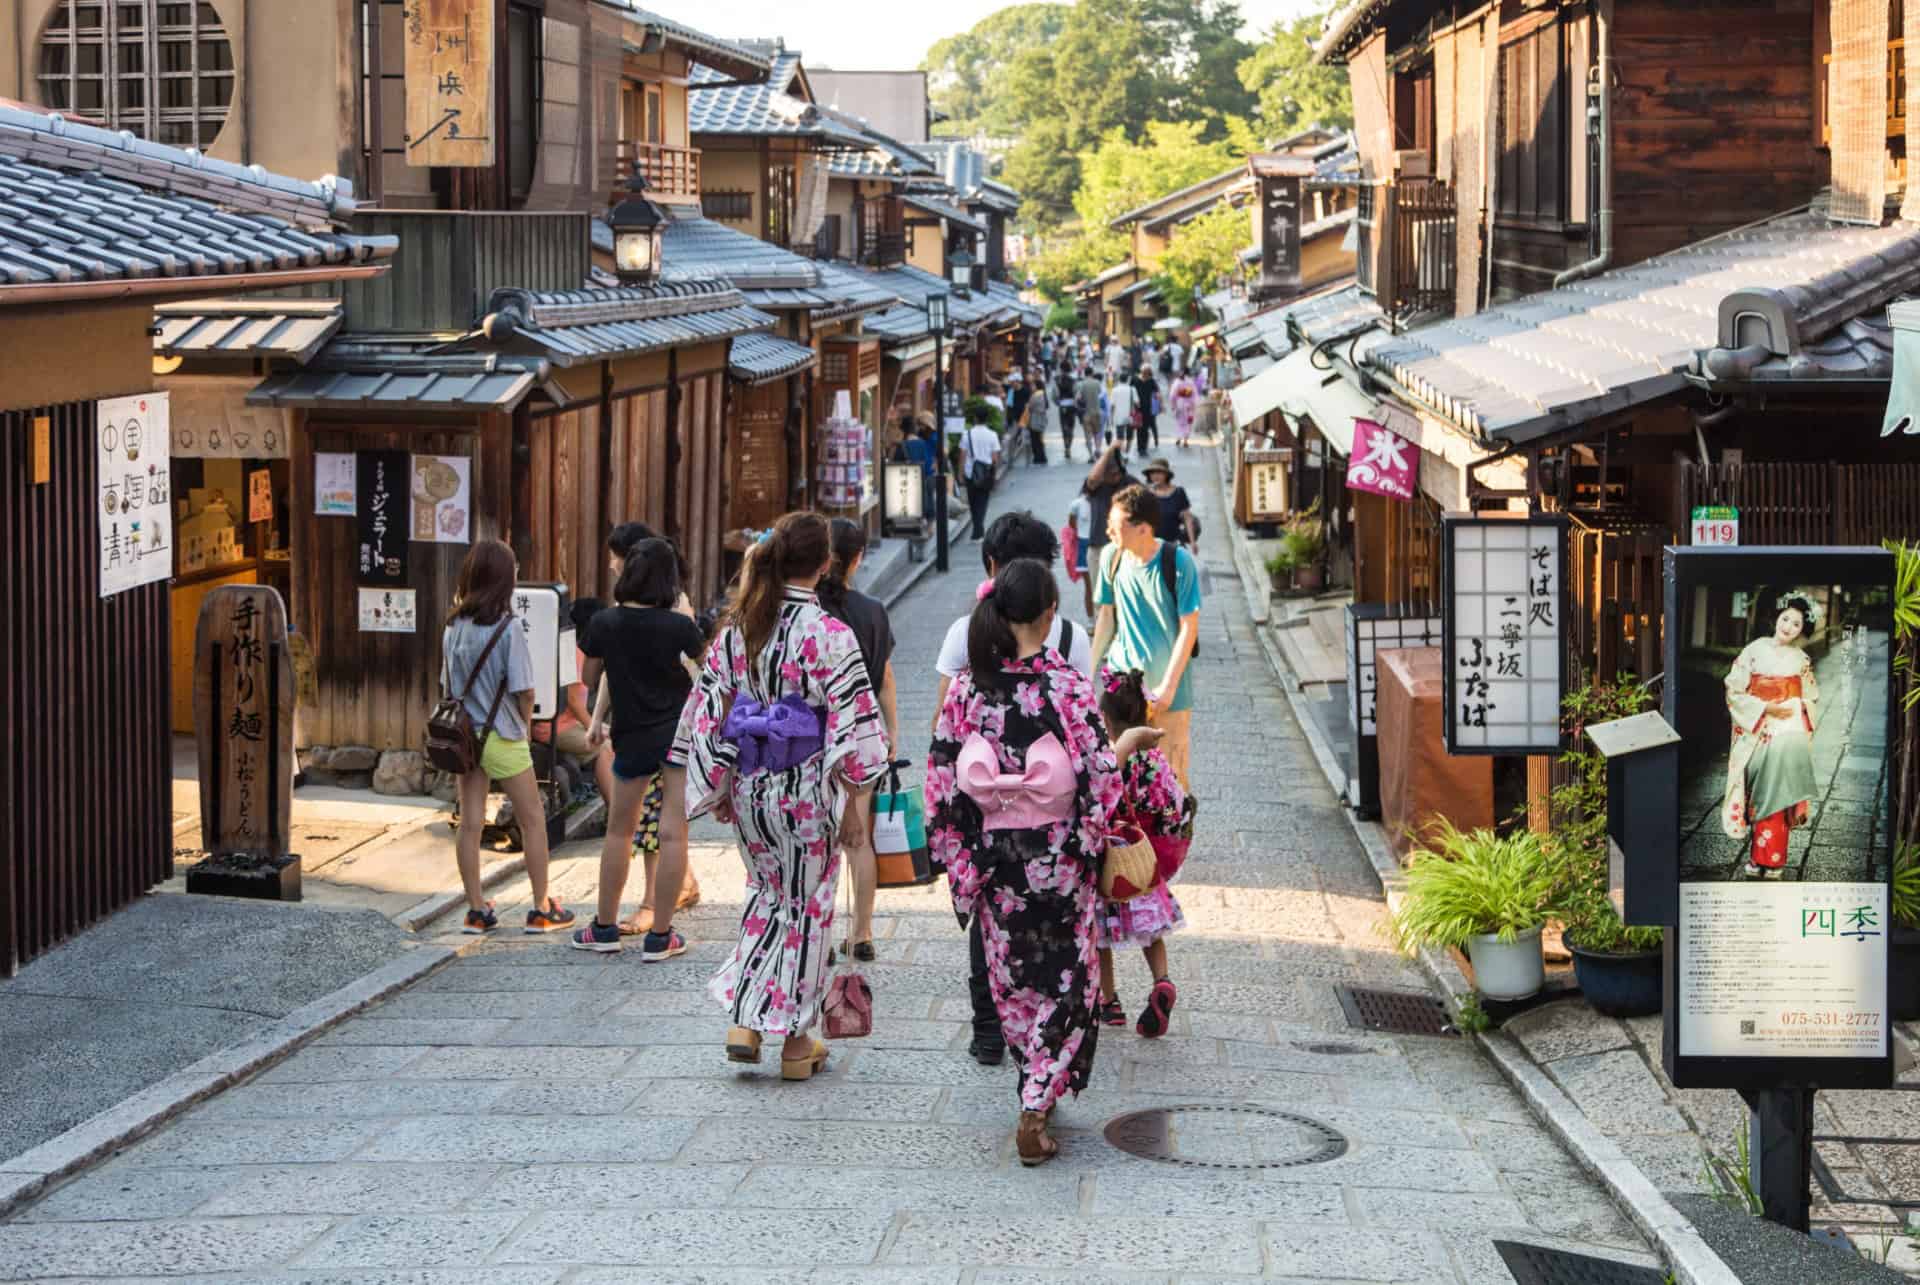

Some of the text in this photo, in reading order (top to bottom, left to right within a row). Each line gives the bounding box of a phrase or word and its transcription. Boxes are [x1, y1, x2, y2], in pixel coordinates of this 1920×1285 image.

[1362, 430, 1408, 471] 氷
[371, 492, 390, 567] ジェラート
[1696, 524, 1733, 542] 119
[1528, 545, 1554, 627] そば処
[1496, 597, 1523, 678] 二寧坂
[230, 596, 264, 840] 手作り麺 小松うどん
[1460, 638, 1496, 728] ふたば
[1801, 905, 1881, 942] 四季
[1781, 1012, 1880, 1026] 075-531-2777
